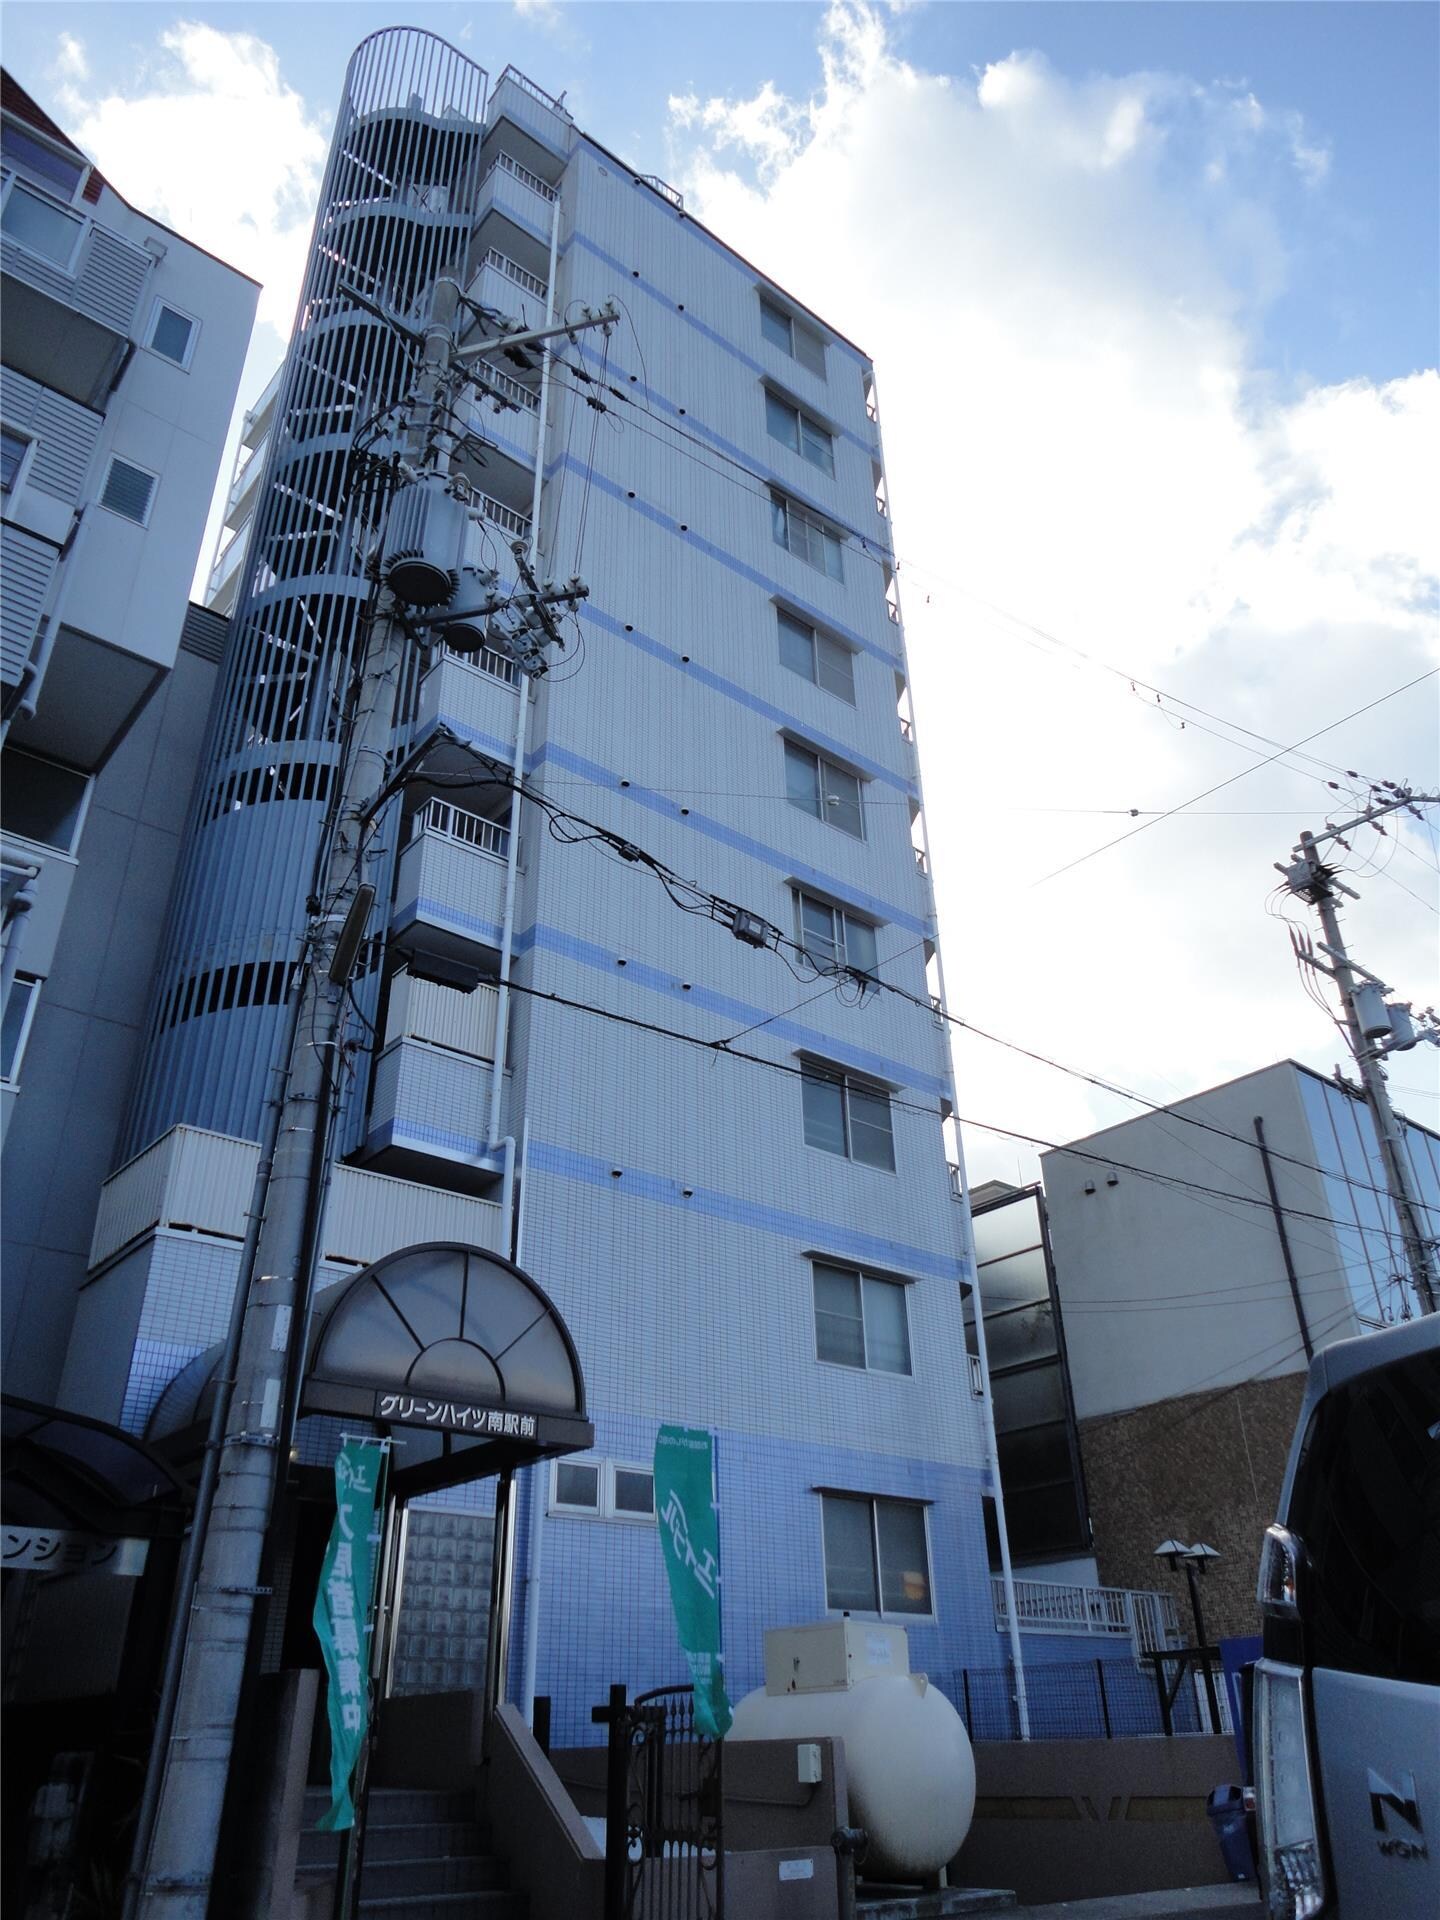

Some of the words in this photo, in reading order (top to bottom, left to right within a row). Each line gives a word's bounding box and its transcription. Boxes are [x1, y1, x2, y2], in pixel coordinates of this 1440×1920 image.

[380, 1395, 536, 1437] グリーンハイツ南駅前
[1366, 1767, 1424, 1835] N
